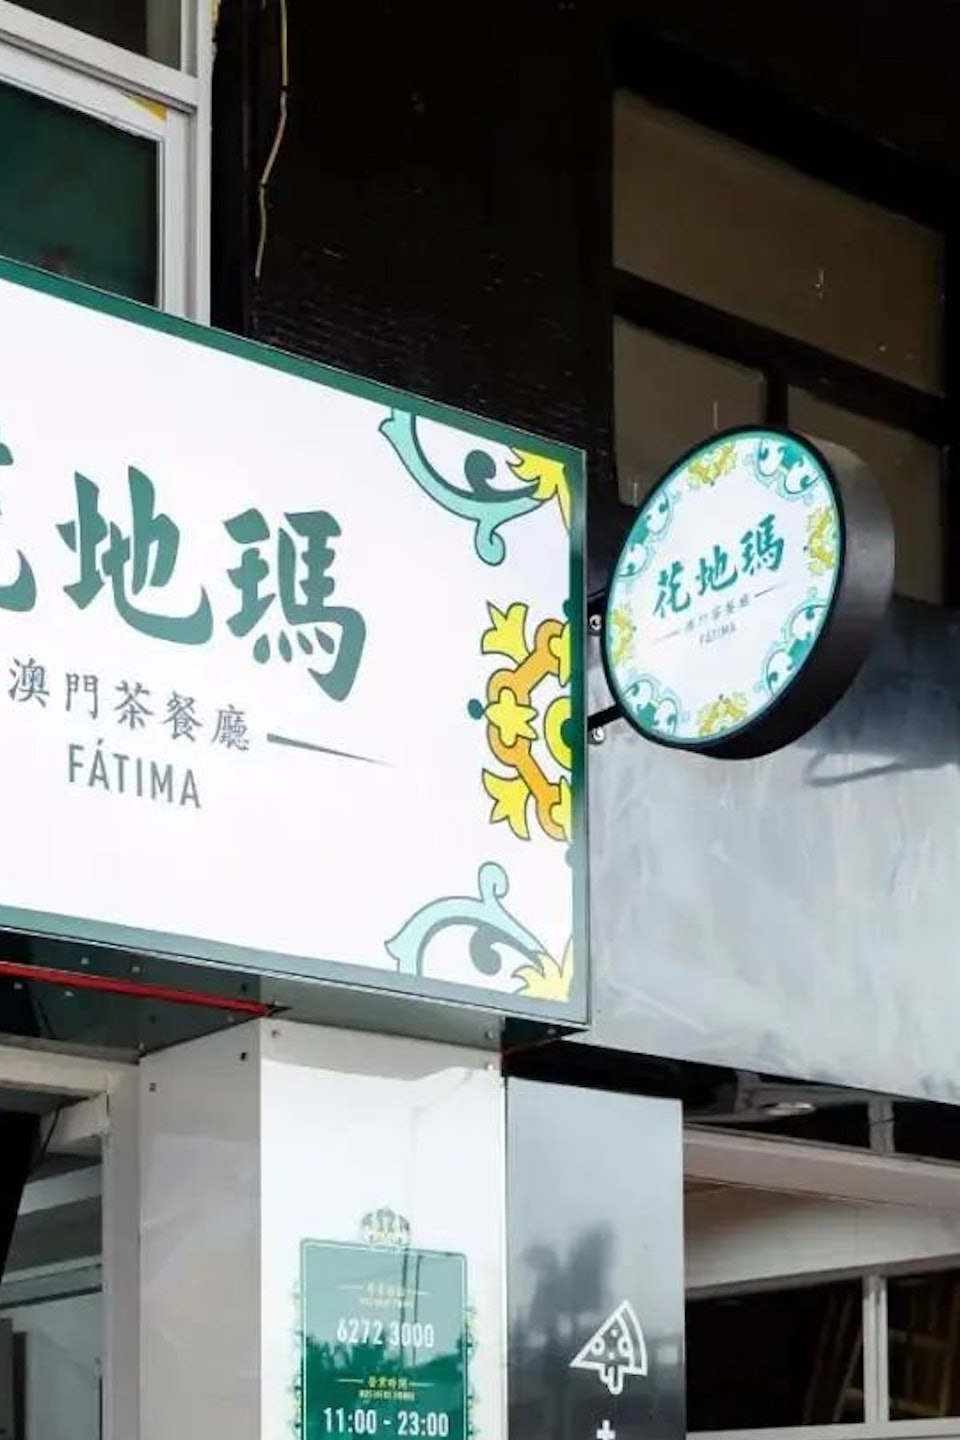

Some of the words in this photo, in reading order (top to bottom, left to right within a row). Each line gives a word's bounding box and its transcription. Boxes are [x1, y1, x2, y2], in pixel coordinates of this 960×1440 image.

[653, 513, 785, 619] 花地瑪
[8, 657, 250, 752] 澳門茶餐廳
[67, 738, 202, 808] FÁTIMA
[337, 1318, 384, 1346] 6272
[324, 1406, 377, 1435] 11:00
[397, 1411, 450, 1438] 23:00
